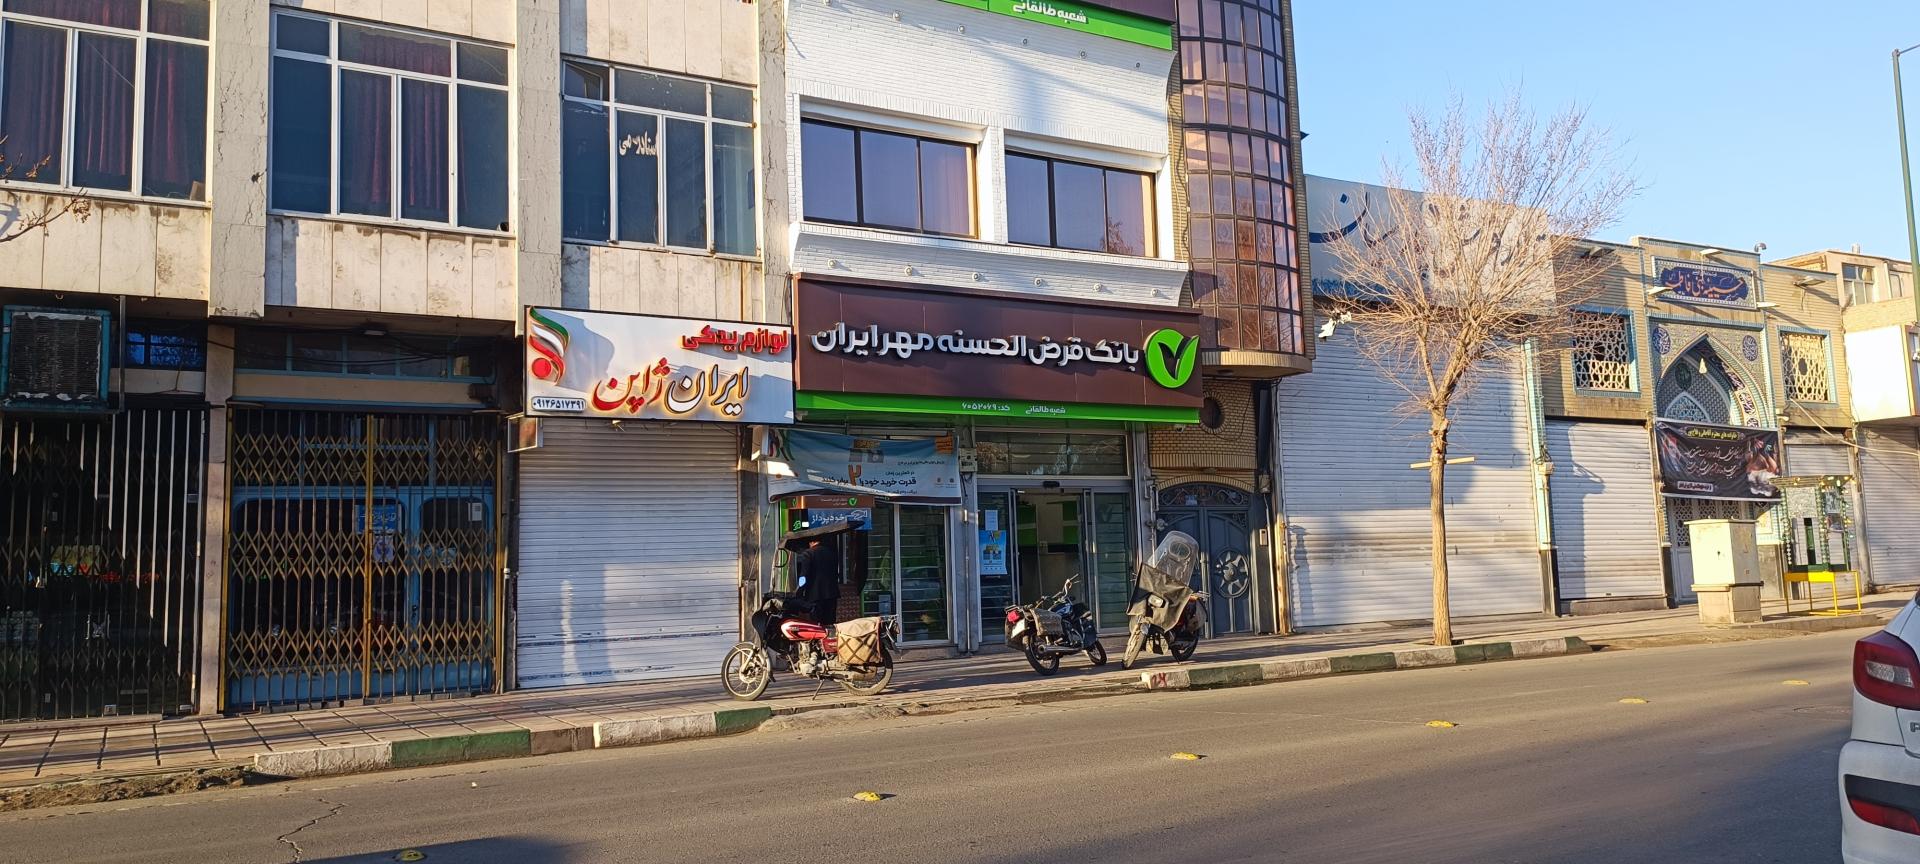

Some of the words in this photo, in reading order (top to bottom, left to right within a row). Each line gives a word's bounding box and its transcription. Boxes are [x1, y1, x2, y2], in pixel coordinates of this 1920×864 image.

[1012, 0, 1057, 17] طالقانی
[1057, 9, 1087, 24] شعبه
[682, 324, 738, 351] یدکی
[740, 328, 788, 354] لوازم
[810, 321, 878, 356] ایران
[878, 331, 934, 359] مهر
[937, 329, 1027, 357] الحسنه
[1028, 335, 1083, 366] قرض
[1085, 338, 1139, 372] بانک
[591, 356, 672, 415] ژاپن
[664, 363, 749, 416] ایران
[1025, 404, 1050, 415] طالقانی
[1049, 406, 1066, 416] شعبه
[848, 464, 862, 487] ۲
[865, 478, 880, 487] خود
[880, 478, 897, 487] خرید
[898, 477, 917, 487] قدرت
[811, 513, 845, 525] خودپرداز
